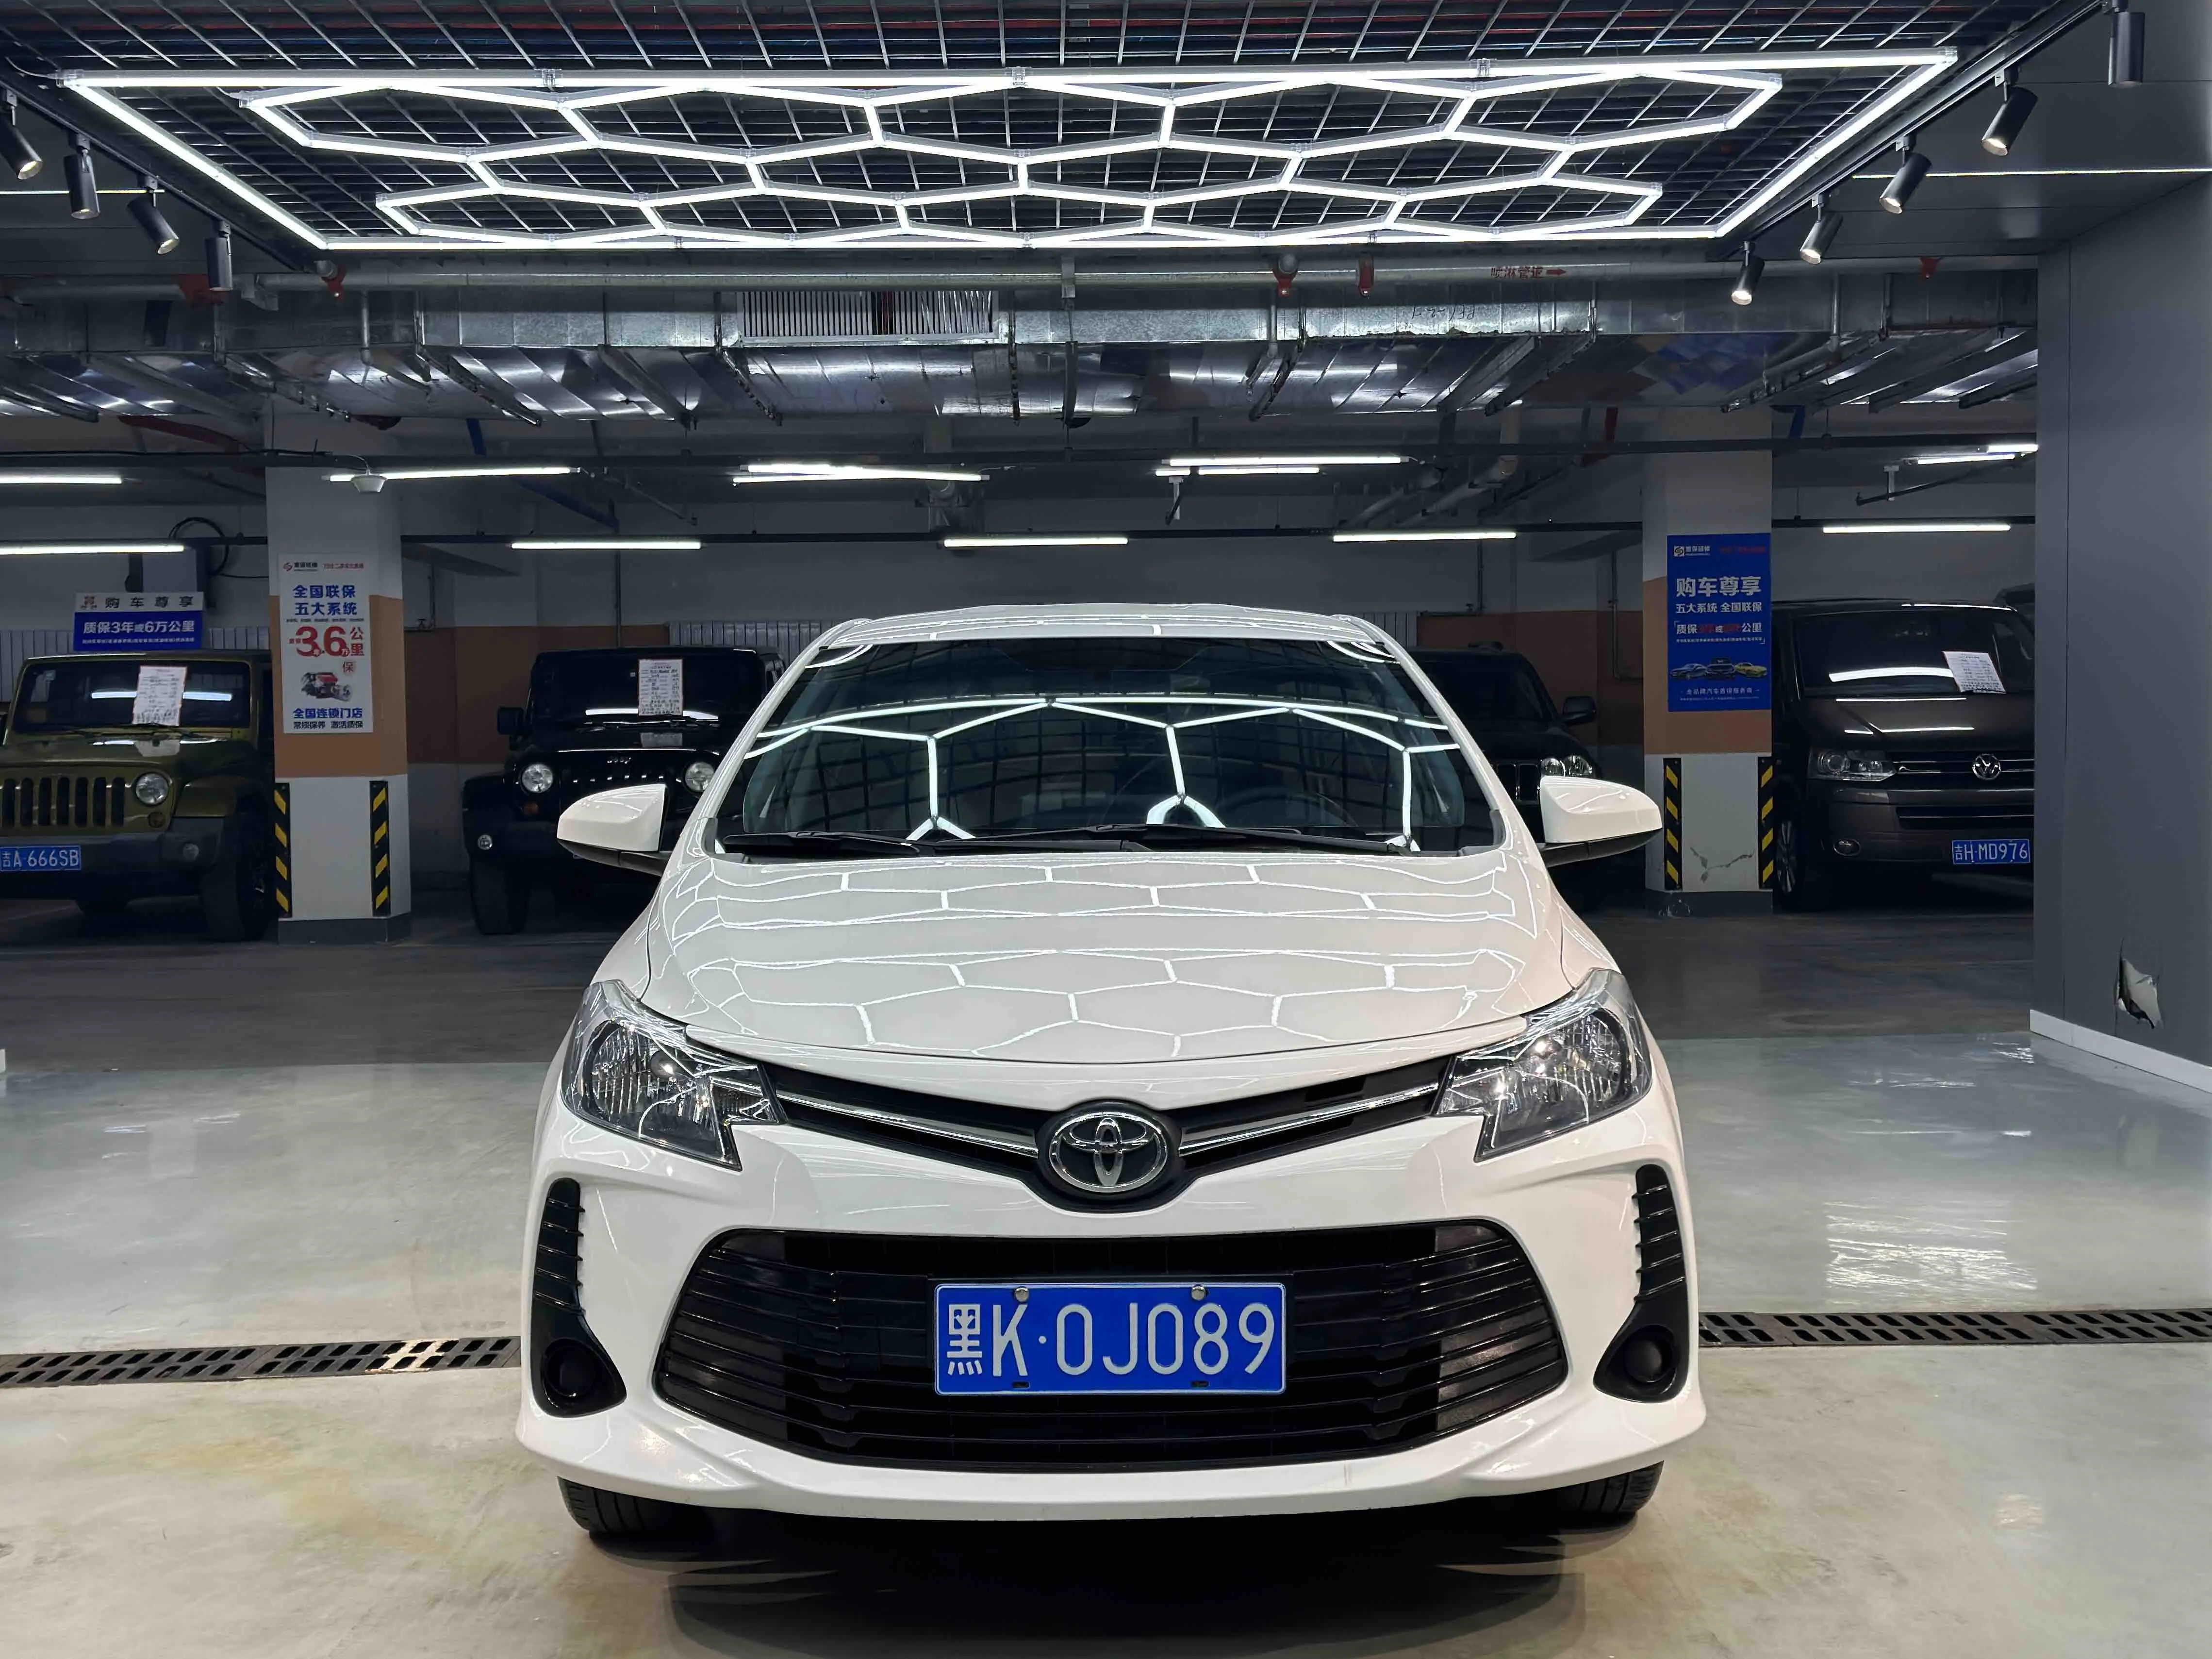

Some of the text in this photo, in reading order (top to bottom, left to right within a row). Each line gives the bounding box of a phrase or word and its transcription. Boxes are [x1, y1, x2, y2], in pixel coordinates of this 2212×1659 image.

[293, 584, 356, 598] 全国联保
[1676, 576, 1762, 597] 购车尊享
[105, 596, 194, 608] 购车尊享
[295, 602, 357, 615] 五大系统
[1676, 601, 1762, 614] 五大系统 全国联保
[293, 708, 363, 719] 全国连锁门店
